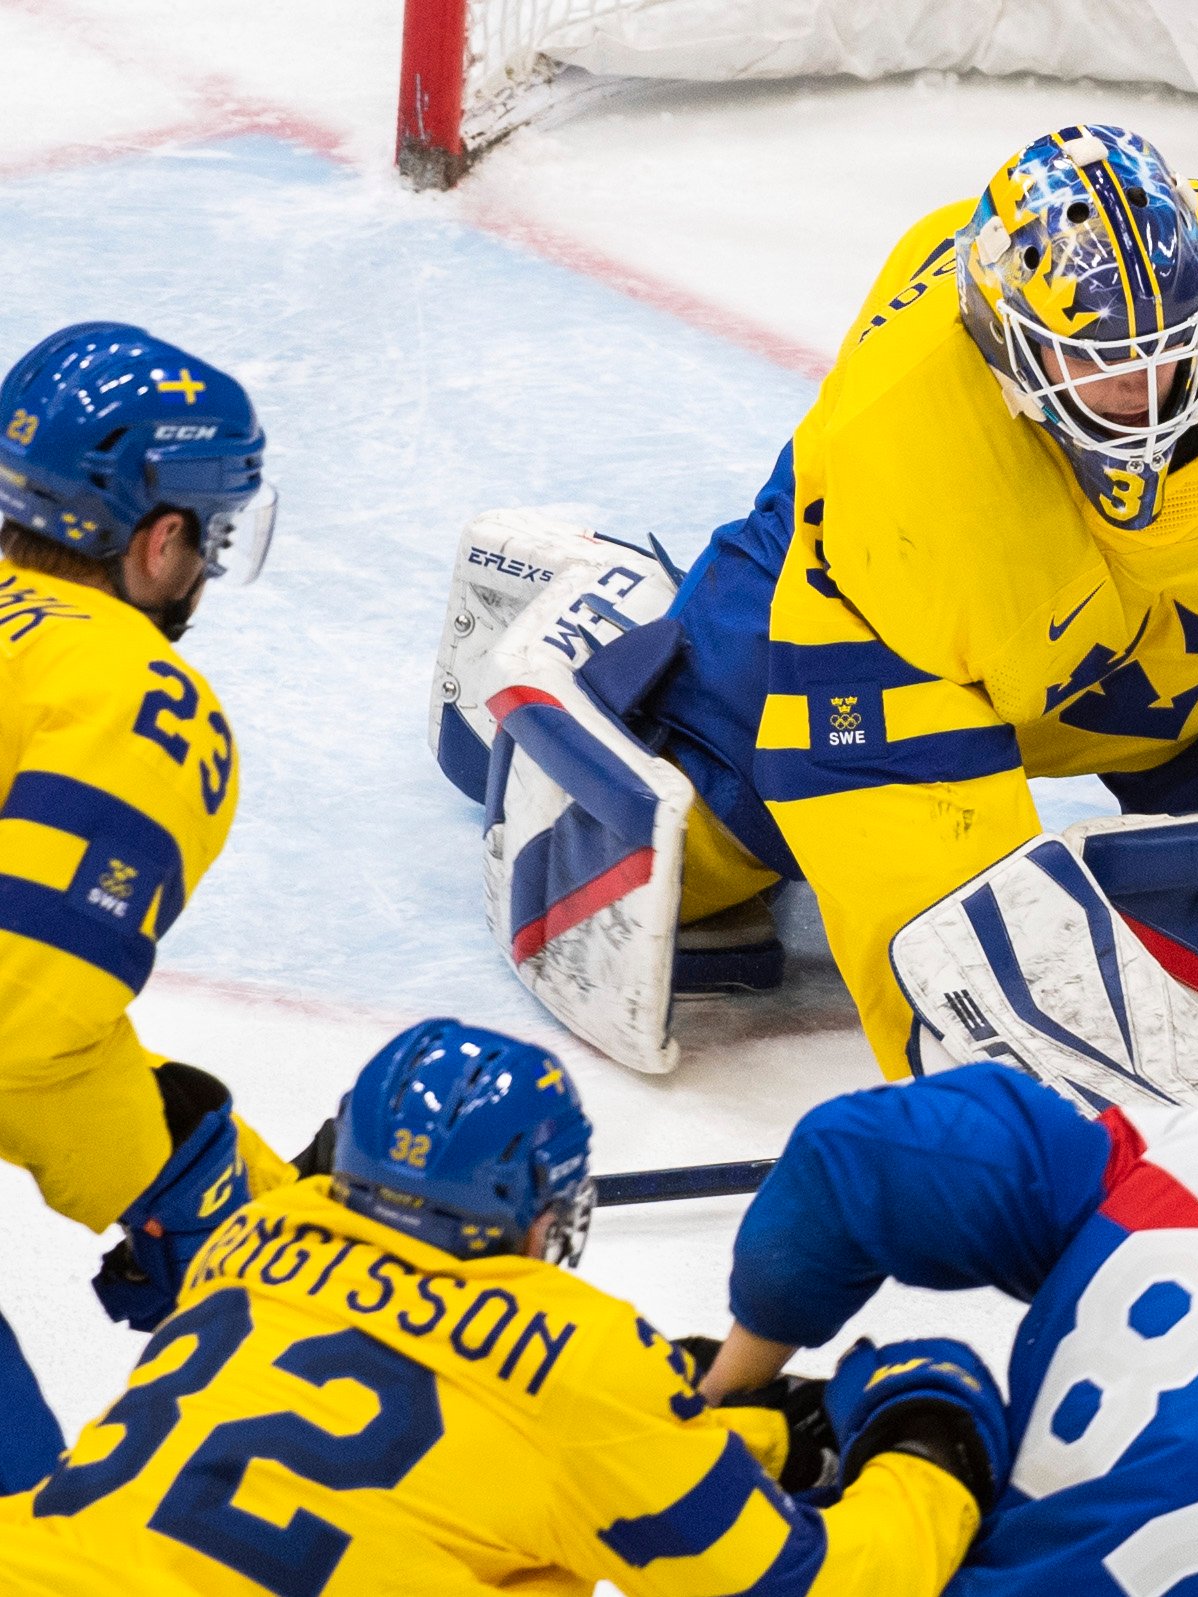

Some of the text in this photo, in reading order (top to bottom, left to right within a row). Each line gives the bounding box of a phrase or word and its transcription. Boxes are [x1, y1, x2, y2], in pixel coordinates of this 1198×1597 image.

[6, 409, 39, 447] 23
[154, 425, 218, 441] CCM
[133, 660, 233, 815] 23
[829, 730, 866, 746] SWE
[86, 887, 127, 917] SWE
[390, 1128, 431, 1169] 32
[190, 1214, 576, 1395] ENGTSSON
[32, 1287, 445, 1597] 32
